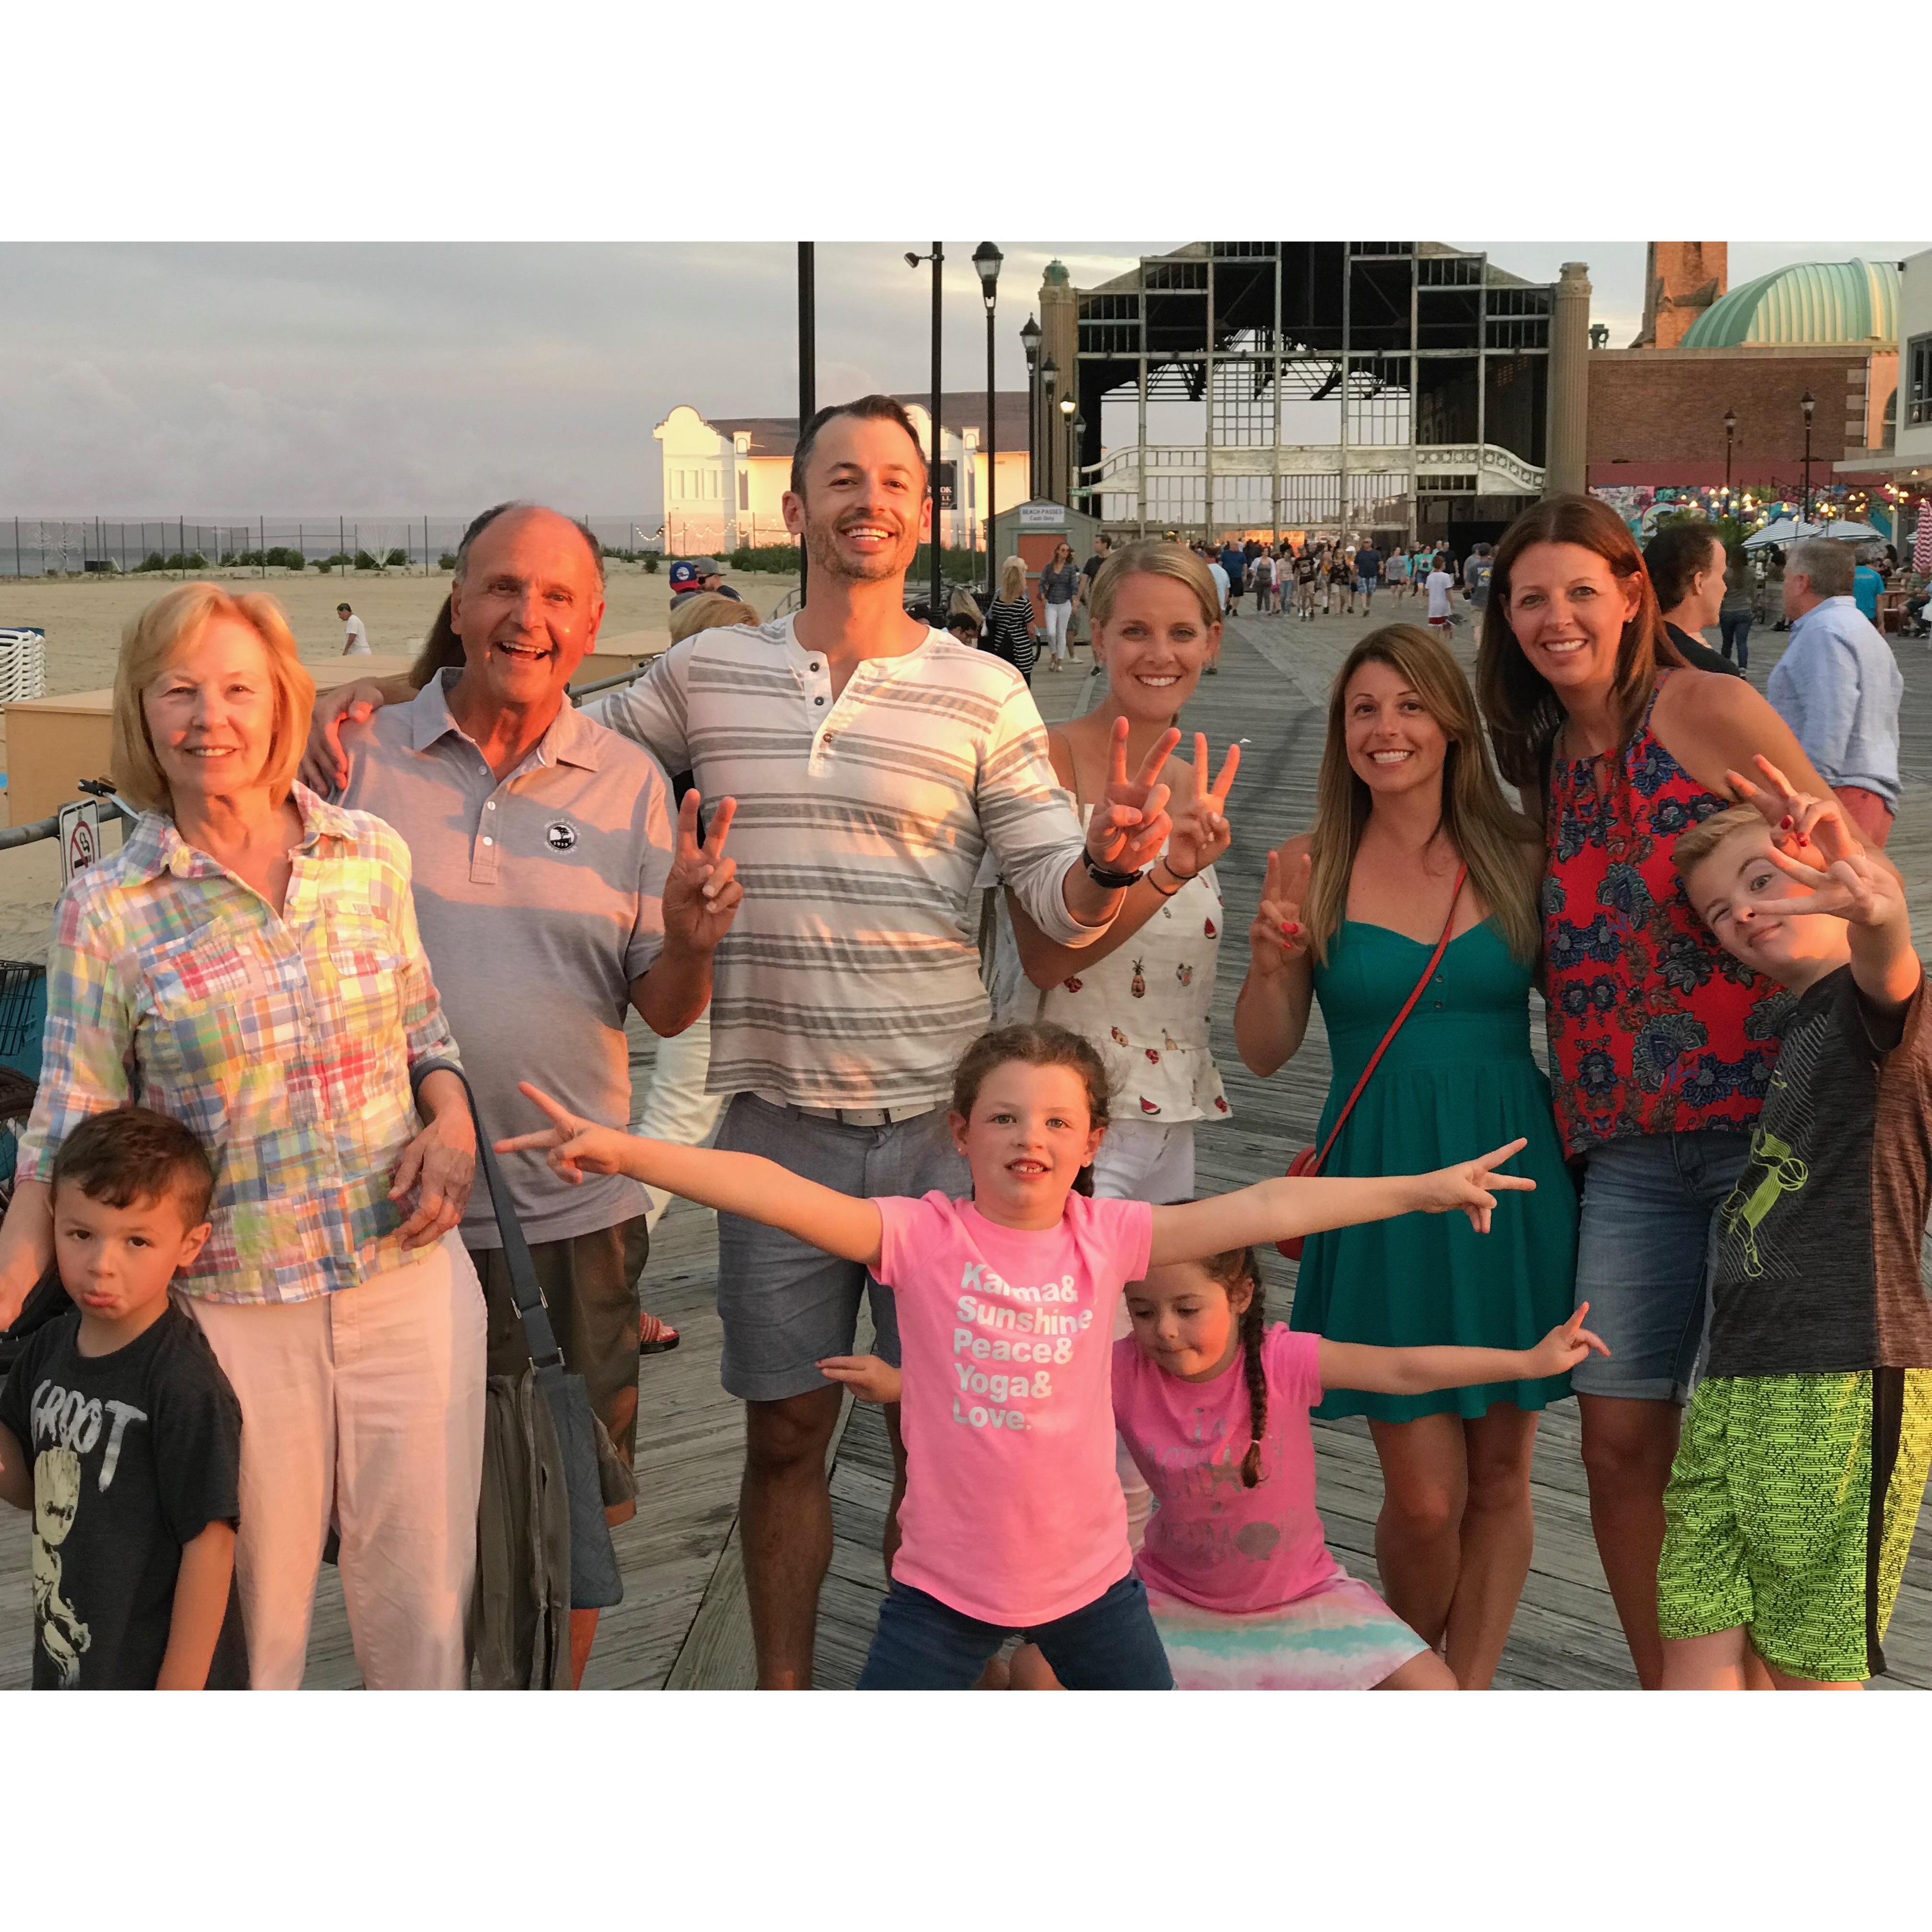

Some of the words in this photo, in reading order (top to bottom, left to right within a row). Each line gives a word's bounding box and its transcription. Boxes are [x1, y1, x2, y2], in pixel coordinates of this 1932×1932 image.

[956, 1295, 1093, 1335] Sunshine
[954, 1328, 1074, 1365] Peace&
[954, 1363, 1053, 1403] Yoga&
[953, 1396, 1032, 1430] Love.
